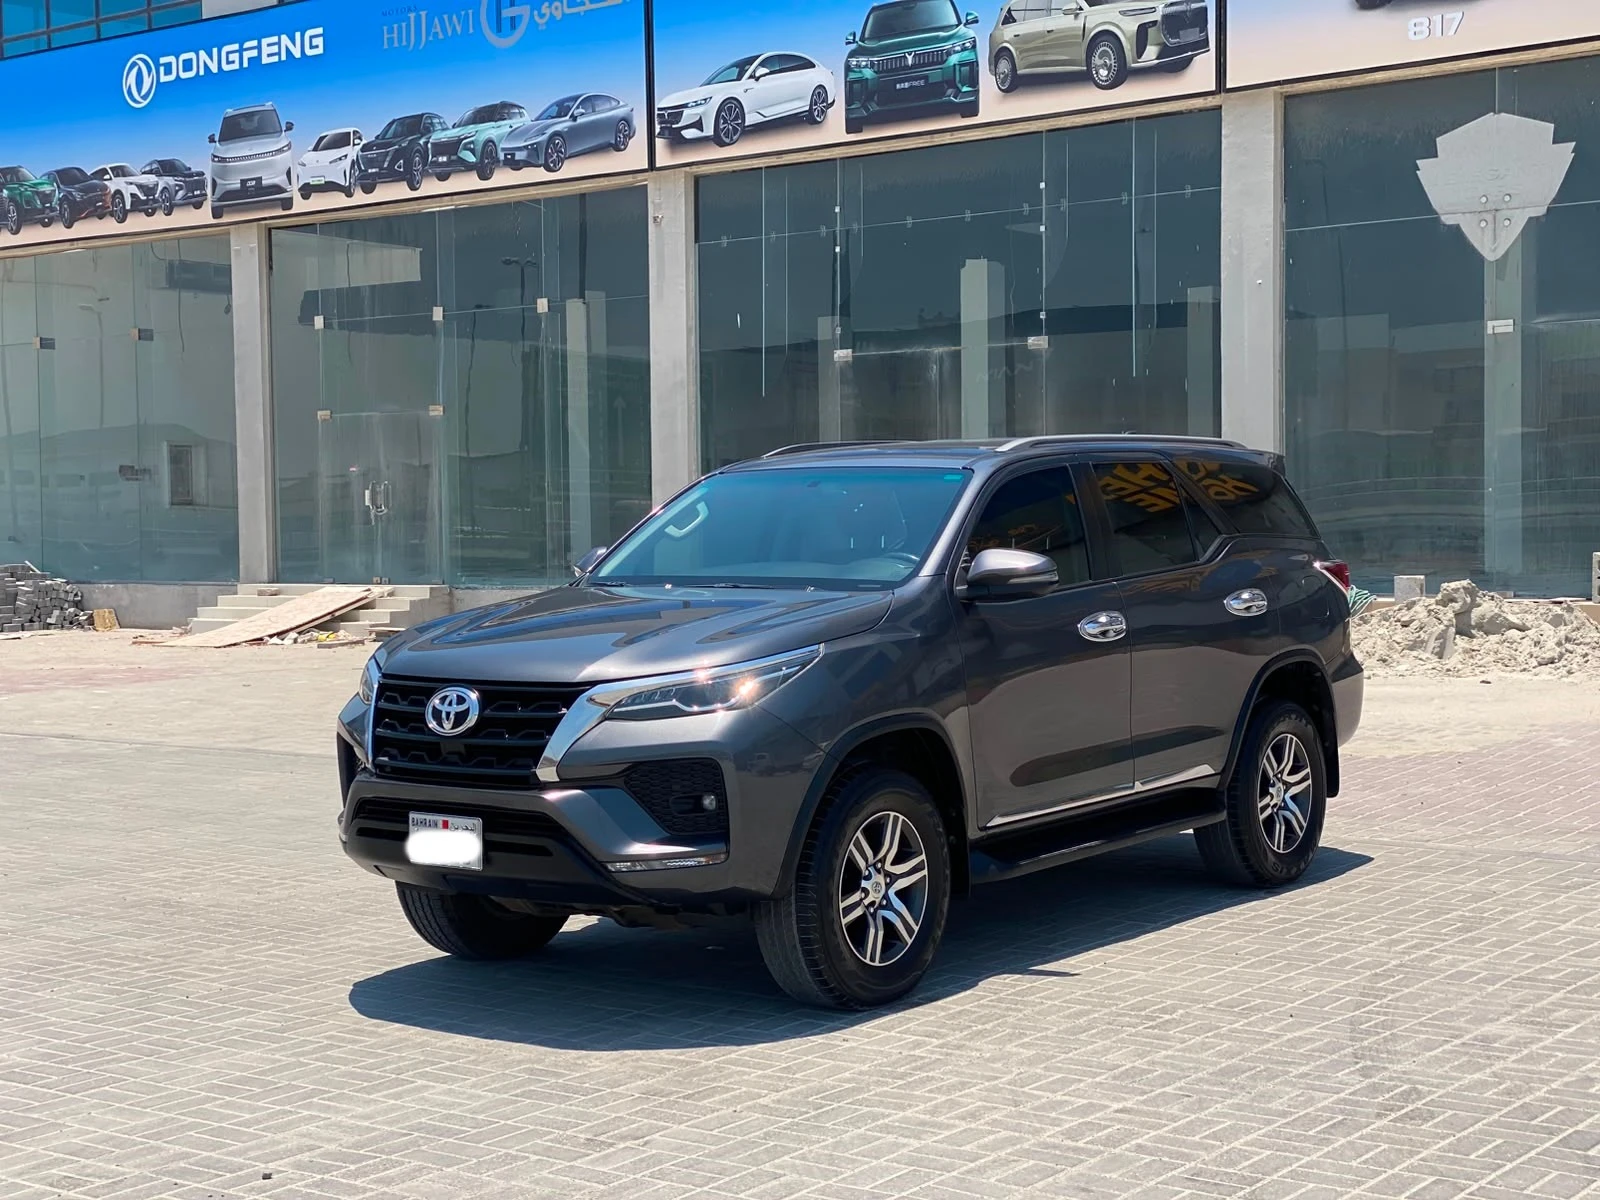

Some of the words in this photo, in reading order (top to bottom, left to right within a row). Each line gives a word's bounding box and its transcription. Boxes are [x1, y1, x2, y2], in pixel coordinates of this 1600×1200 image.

[383, 9, 474, 51] HIJJAWI
[1408, 11, 1464, 40] 817
[159, 27, 324, 83] DONGFENG
[411, 817, 438, 829] BAHRAIN
